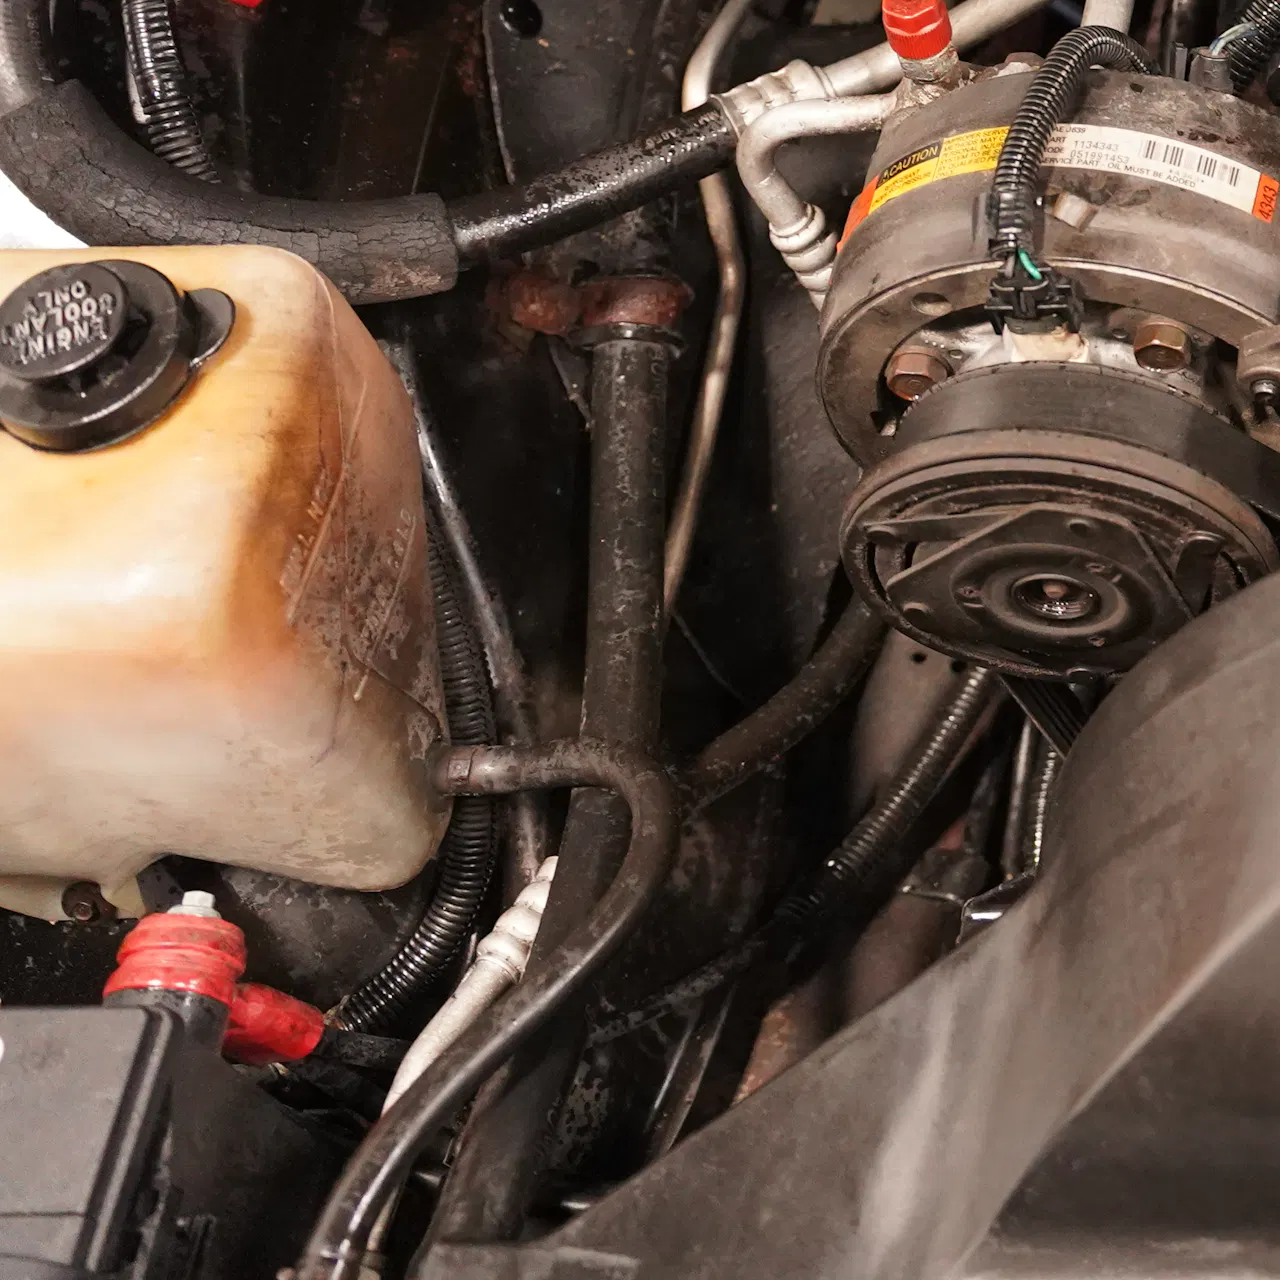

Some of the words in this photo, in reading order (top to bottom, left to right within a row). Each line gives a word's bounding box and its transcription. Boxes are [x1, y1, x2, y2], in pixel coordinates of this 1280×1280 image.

[981, 127, 1009, 138] SERVIC
[1074, 140, 1120, 151] 1134343
[889, 145, 940, 177] CAUTION
[1077, 158, 1101, 167] PART
[1108, 161, 1121, 170] OIL
[1124, 165, 1152, 175] MUST
[1166, 174, 1196, 188] ADDED
[1259, 185, 1278, 220] 4343
[23, 280, 88, 319] ONLY
